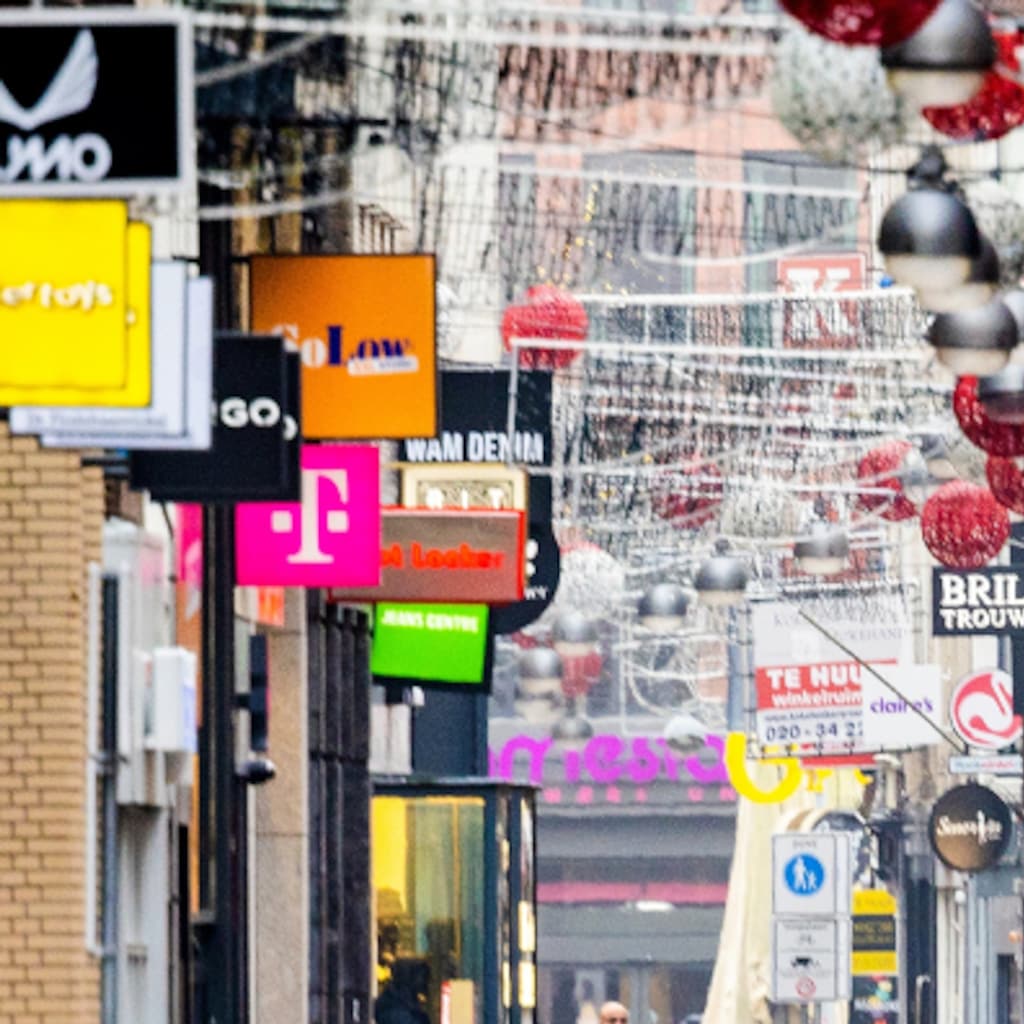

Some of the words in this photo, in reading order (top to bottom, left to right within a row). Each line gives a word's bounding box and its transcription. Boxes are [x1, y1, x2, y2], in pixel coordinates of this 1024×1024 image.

[210, 397, 281, 428] GO
[404, 431, 464, 463] WAM
[467, 430, 545, 464] DENIM
[411, 541, 506, 569] Locker
[766, 667, 800, 690] TE
[869, 694, 934, 715] claire's
[766, 723, 800, 742] 020
[815, 722, 838, 739] 34
